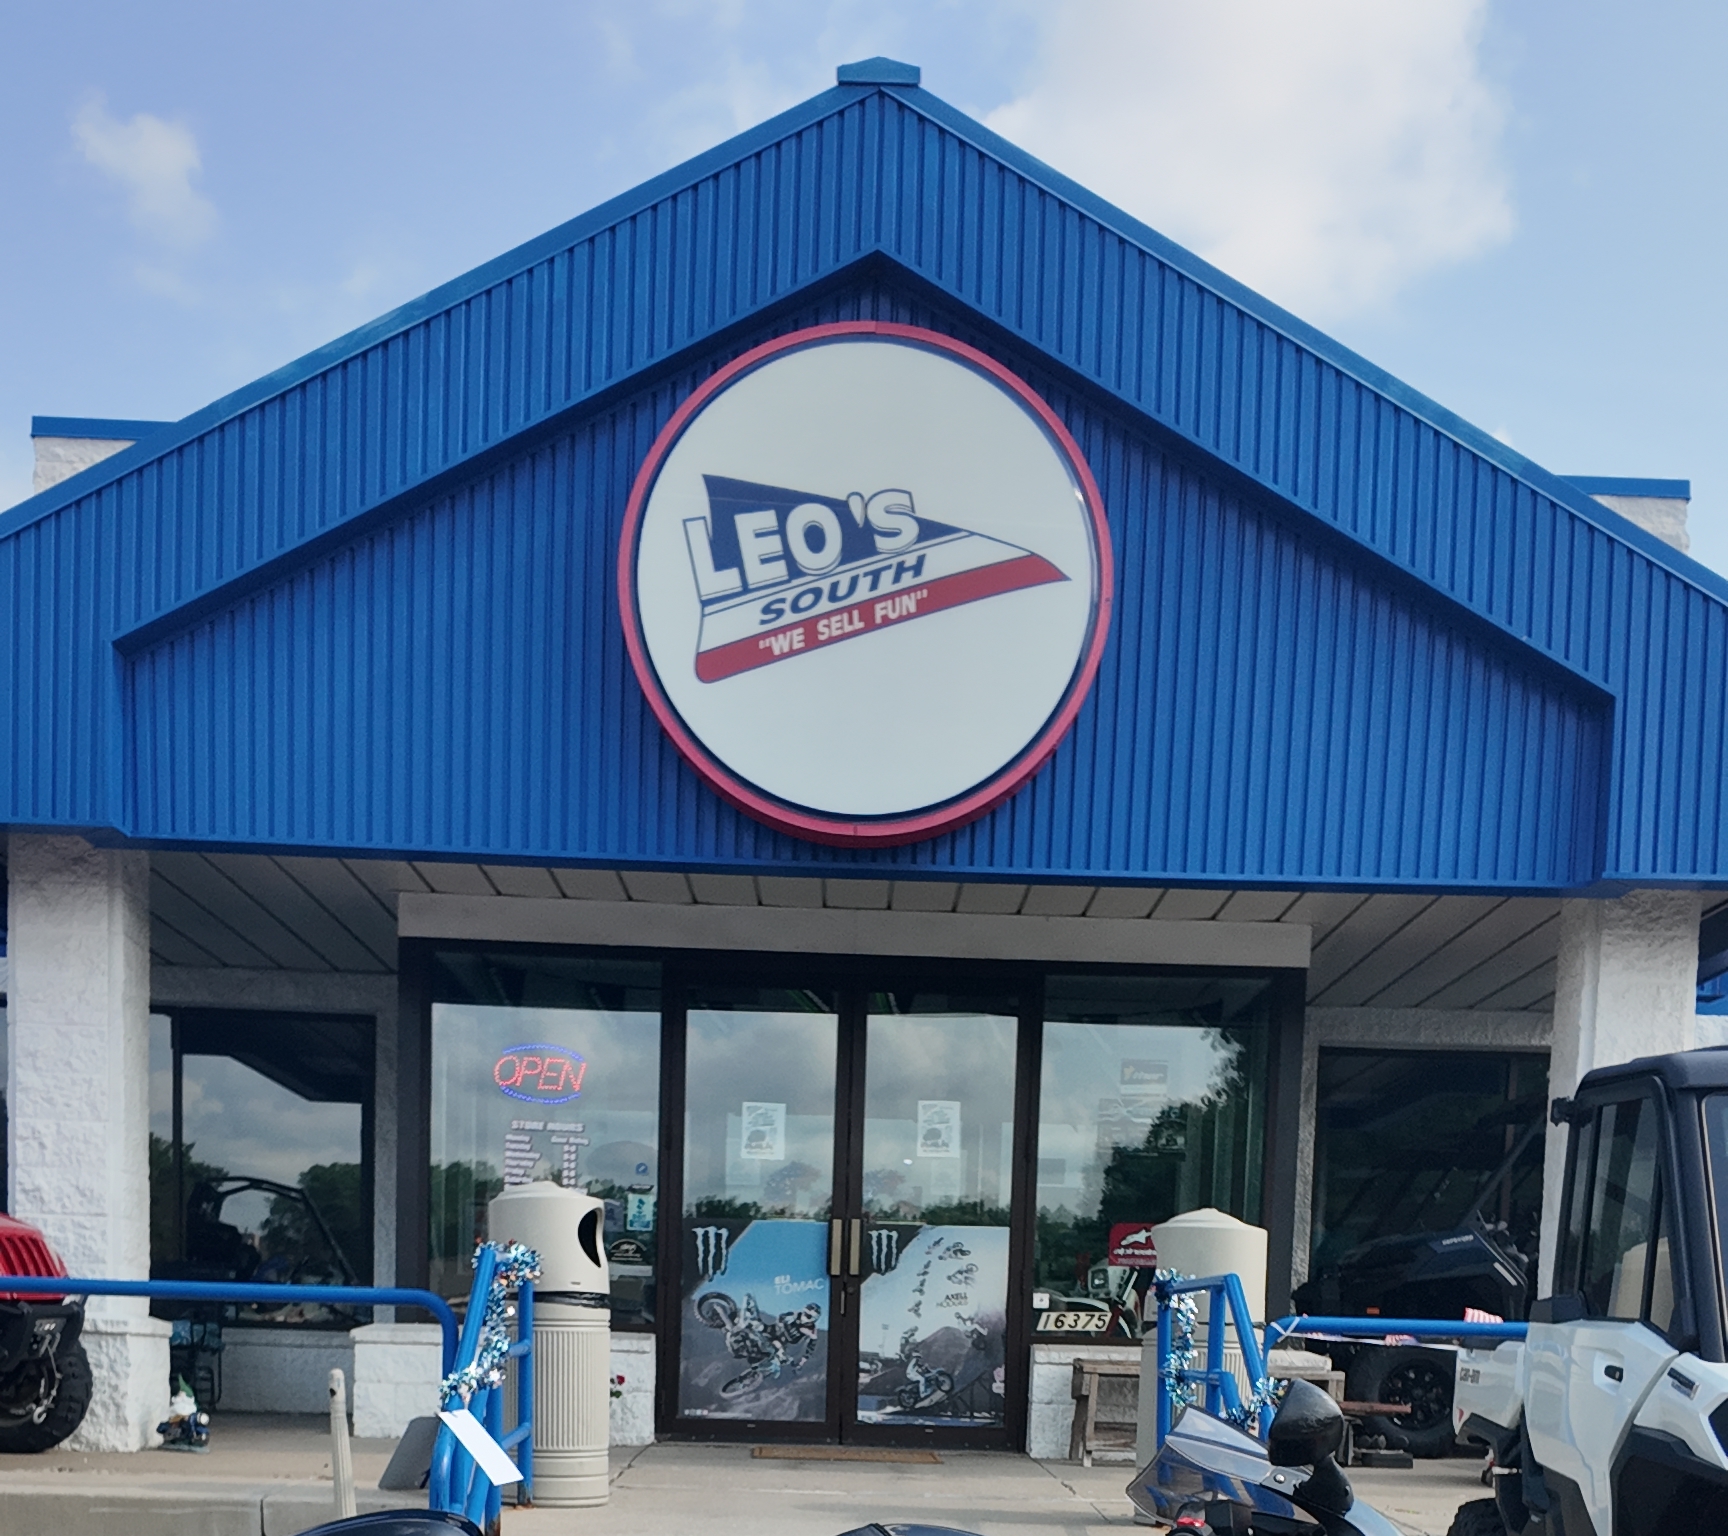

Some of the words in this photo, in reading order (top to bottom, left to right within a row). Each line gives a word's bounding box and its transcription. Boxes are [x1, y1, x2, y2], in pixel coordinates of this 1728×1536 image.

[682, 488, 920, 604] LEO'S
[759, 553, 927, 625] SOUTH
[758, 627, 806, 656] "WE
[816, 612, 866, 641] SELL
[875, 588, 929, 624] FUN"
[493, 1055, 587, 1092] OPEN
[774, 1278, 825, 1295] TOMAC
[1042, 1313, 1109, 1330] 16375
